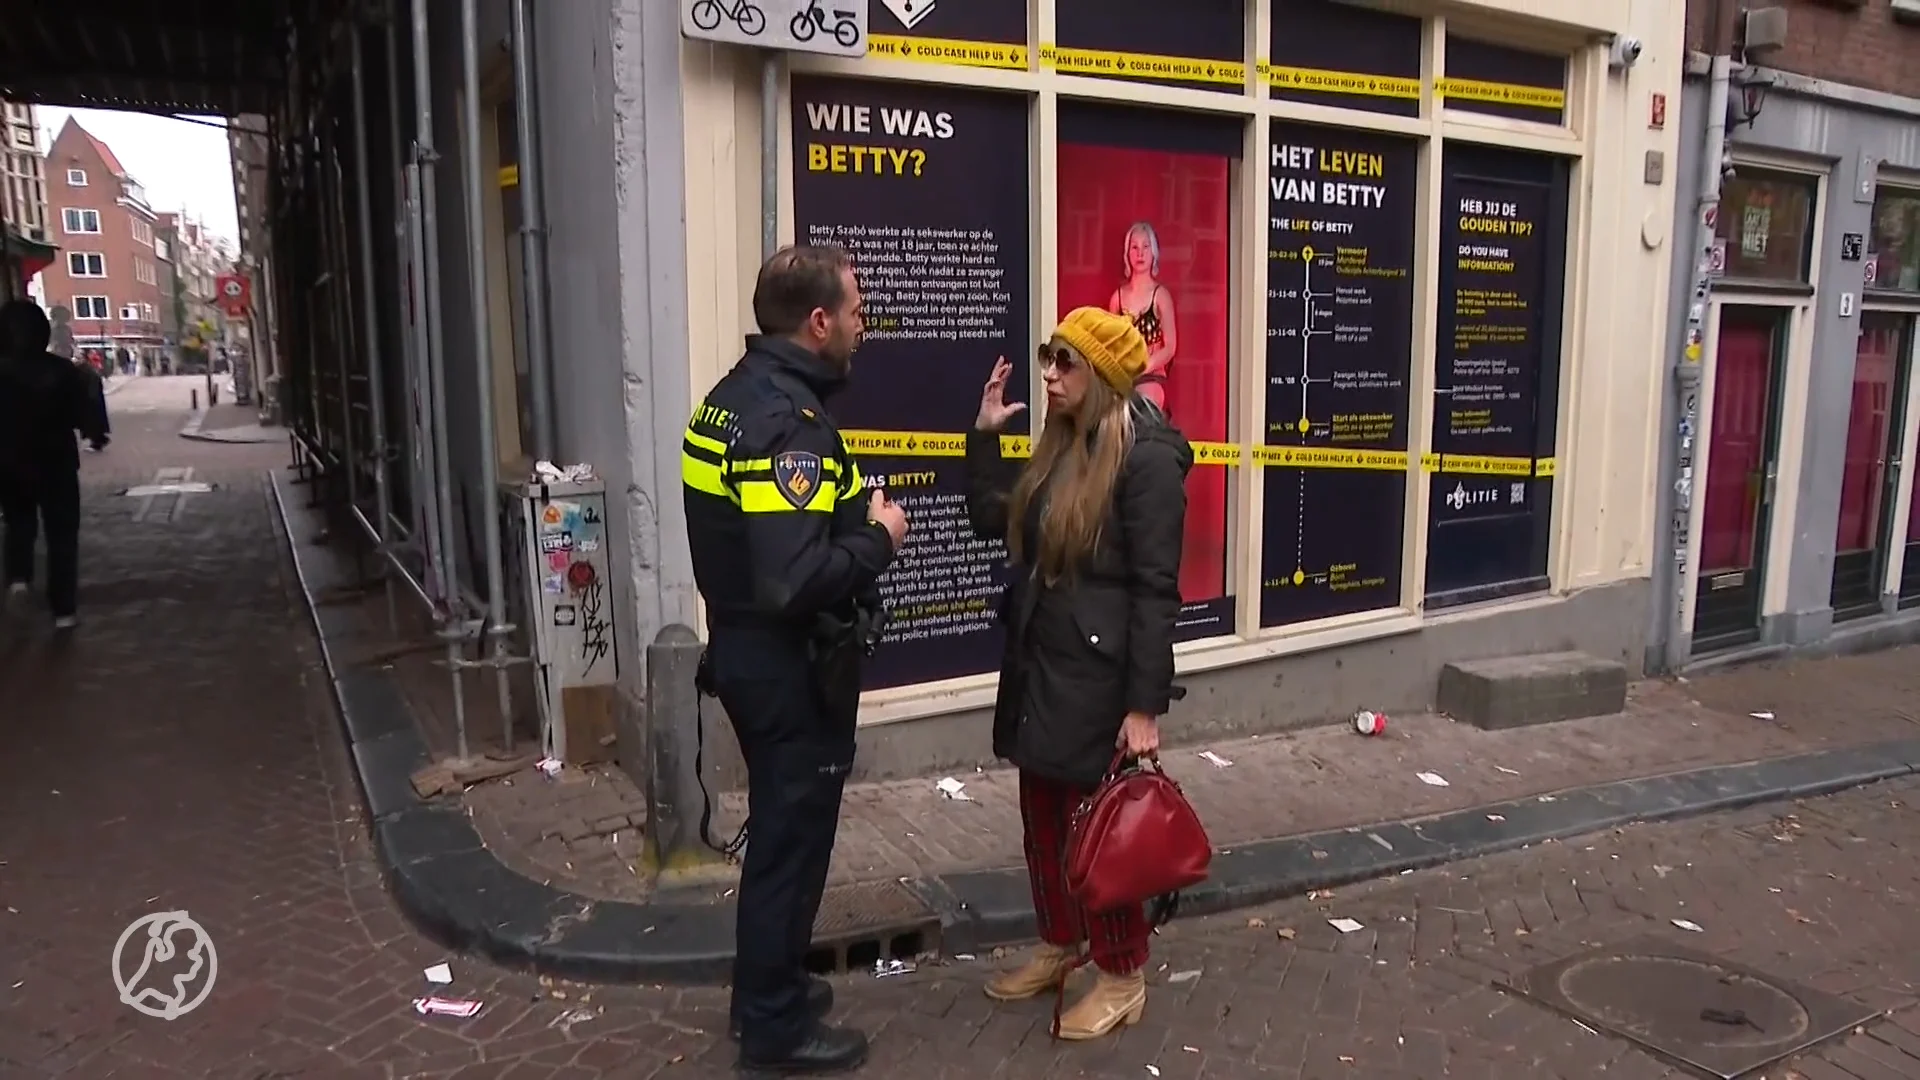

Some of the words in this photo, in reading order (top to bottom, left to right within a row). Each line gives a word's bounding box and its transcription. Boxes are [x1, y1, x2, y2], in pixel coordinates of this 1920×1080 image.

[917, 46, 942, 56] COLD
[945, 48, 967, 58] CASE
[969, 50, 990, 60] HELP
[992, 52, 1004, 61] US
[1074, 57, 1092, 66] HELP
[1130, 61, 1150, 71] COLD
[1152, 62, 1171, 72] CASE
[1173, 64, 1190, 74] HELP
[1192, 67, 1202, 75] US
[1218, 68, 1238, 77] COLD
[1305, 76, 1322, 85] COLD
[806, 102, 870, 133] WIE
[880, 108, 954, 138] WAS
[808, 143, 926, 176] BETTY?
[1272, 144, 1314, 170] HET
[1320, 149, 1383, 177] LEVEN
[1271, 177, 1315, 203] VAN
[1323, 182, 1385, 208] BETTY
[1460, 199, 1482, 213] HEB
[1484, 202, 1499, 216] JIJ
[1502, 203, 1516, 217] DE
[809, 225, 835, 239] Betty
[837, 225, 866, 236] Szabó
[868, 226, 900, 236] werkte
[901, 227, 915, 237] als
[917, 227, 967, 238] sekswerker
[969, 231, 981, 240] op
[982, 229, 994, 239] de
[1271, 218, 1289, 230] THE
[1291, 219, 1309, 231] LIFE
[1312, 220, 1325, 232] OF
[1326, 222, 1353, 234] BETTY
[1460, 217, 1506, 233] GOUDEN
[1510, 221, 1533, 236] TIP?
[849, 239, 861, 248] Ze
[863, 240, 882, 249] was
[884, 240, 898, 250] net
[902, 240, 914, 250] 18
[915, 241, 936, 252] jaar,
[937, 241, 957, 251] toen
[960, 242, 969, 251] ze
[971, 241, 998, 252] achter
[1459, 245, 1470, 255] DO
[1472, 247, 1488, 256] YOU
[1489, 248, 1508, 258] HAVE
[857, 251, 903, 262] belandde.
[905, 253, 929, 265] Betty
[931, 254, 960, 263] werkte
[962, 253, 982, 264] hard
[984, 256, 995, 264] en
[852, 267, 874, 277] ange
[876, 265, 908, 276] dagen,
[956, 268, 966, 276] ze
[968, 268, 1004, 279] zwanger
[1458, 260, 1515, 272] INFORMATION?
[860, 277, 883, 288] bleef
[885, 277, 919, 288] klanten
[921, 279, 968, 291] ontvangen
[970, 279, 981, 288] tot
[983, 279, 1000, 289] kort
[896, 291, 920, 303] Betty
[922, 291, 946, 303] kreeg
[949, 292, 965, 301] een
[967, 292, 990, 301] zoon.
[992, 291, 1011, 301] Kort
[872, 305, 883, 314] ze
[885, 303, 928, 314] vermoord
[930, 303, 939, 313] in
[941, 305, 957, 314] een
[959, 303, 1008, 316] peeskamer.
[866, 317, 877, 327] 19
[880, 317, 899, 328] jaar.
[902, 317, 915, 326] De
[917, 316, 945, 327] moord
[948, 316, 955, 326] is
[957, 316, 994, 326] ondanks
[863, 329, 938, 342] politieonderzoek
[940, 330, 957, 341] nog
[959, 329, 987, 339] steeds
[989, 328, 1005, 339] niet
[1271, 377, 1284, 385] FEB.
[858, 438, 881, 449] HELP
[883, 439, 901, 449] MEE
[922, 439, 947, 450] COLD
[1212, 449, 1230, 459] COLD
[1296, 454, 1312, 462] COLD
[1314, 454, 1328, 463] CASE
[1330, 455, 1344, 463] HELP
[1367, 457, 1381, 465] COLD
[889, 472, 936, 486] BETTY?
[909, 497, 918, 506] in
[920, 495, 933, 505] the
[1446, 480, 1499, 510] POLITIE
[914, 509, 928, 517] sex
[931, 506, 962, 516] worker.
[911, 520, 926, 530] she
[928, 518, 955, 530] began
[934, 530, 957, 542] Betty
[918, 544, 945, 555] hours,
[947, 540, 965, 551] also
[967, 539, 986, 550] after
[988, 538, 1003, 548] she
[904, 558, 920, 569] She
[922, 553, 965, 565] continued
[966, 552, 976, 561] to
[977, 550, 1008, 560] receive
[891, 570, 922, 583] shortly
[923, 566, 951, 578] before
[953, 565, 969, 575] she
[970, 563, 991, 575] gave
[896, 582, 916, 593] birth
[918, 582, 928, 591] to
[936, 580, 955, 589] son.
[957, 576, 973, 586] She
[975, 575, 992, 584] was
[900, 592, 945, 604] afterwards
[947, 590, 956, 599] in
[925, 602, 949, 613] when
[950, 600, 965, 610] she
[966, 598, 988, 610] died.
[912, 614, 951, 628] unsolved
[953, 613, 962, 621] to
[963, 611, 979, 620] this
[980, 609, 998, 621] day,
[902, 630, 929, 643] police
[930, 621, 992, 637] investigations.
